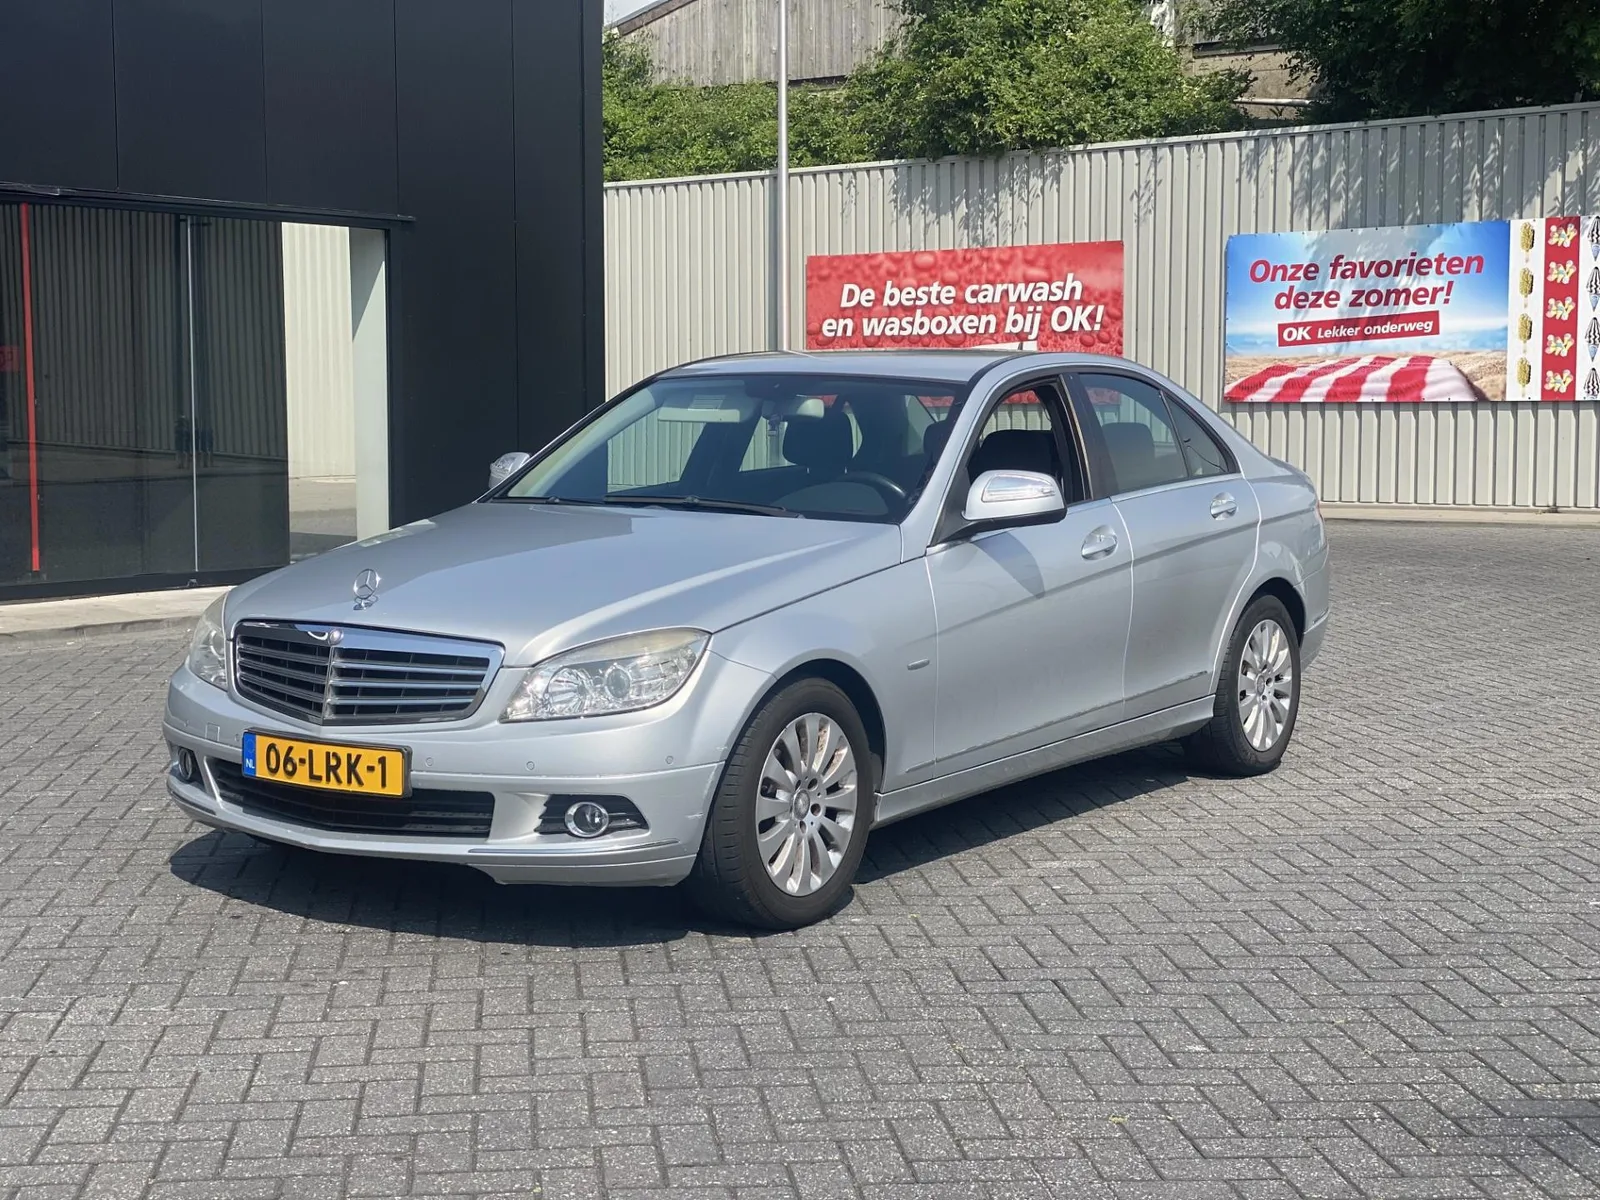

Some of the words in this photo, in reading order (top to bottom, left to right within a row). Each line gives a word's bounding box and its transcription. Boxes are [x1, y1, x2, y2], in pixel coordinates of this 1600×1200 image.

[1250, 259, 1319, 282] Onze
[1330, 252, 1484, 280] favorieten
[840, 283, 875, 308] De
[882, 280, 957, 306] beste
[964, 273, 1083, 304] carwash
[1274, 285, 1341, 310] deze
[1349, 281, 1453, 308] zomer!
[821, 317, 854, 337] en
[862, 309, 997, 337] wasboxen
[1004, 305, 1042, 340] bij
[1050, 304, 1105, 333] OK!
[1283, 326, 1311, 342] OK
[1318, 325, 1360, 338] Lekker
[1364, 320, 1433, 335] onderweg
[246, 759, 255, 769] NL
[266, 743, 387, 788] 06-LRK-1
